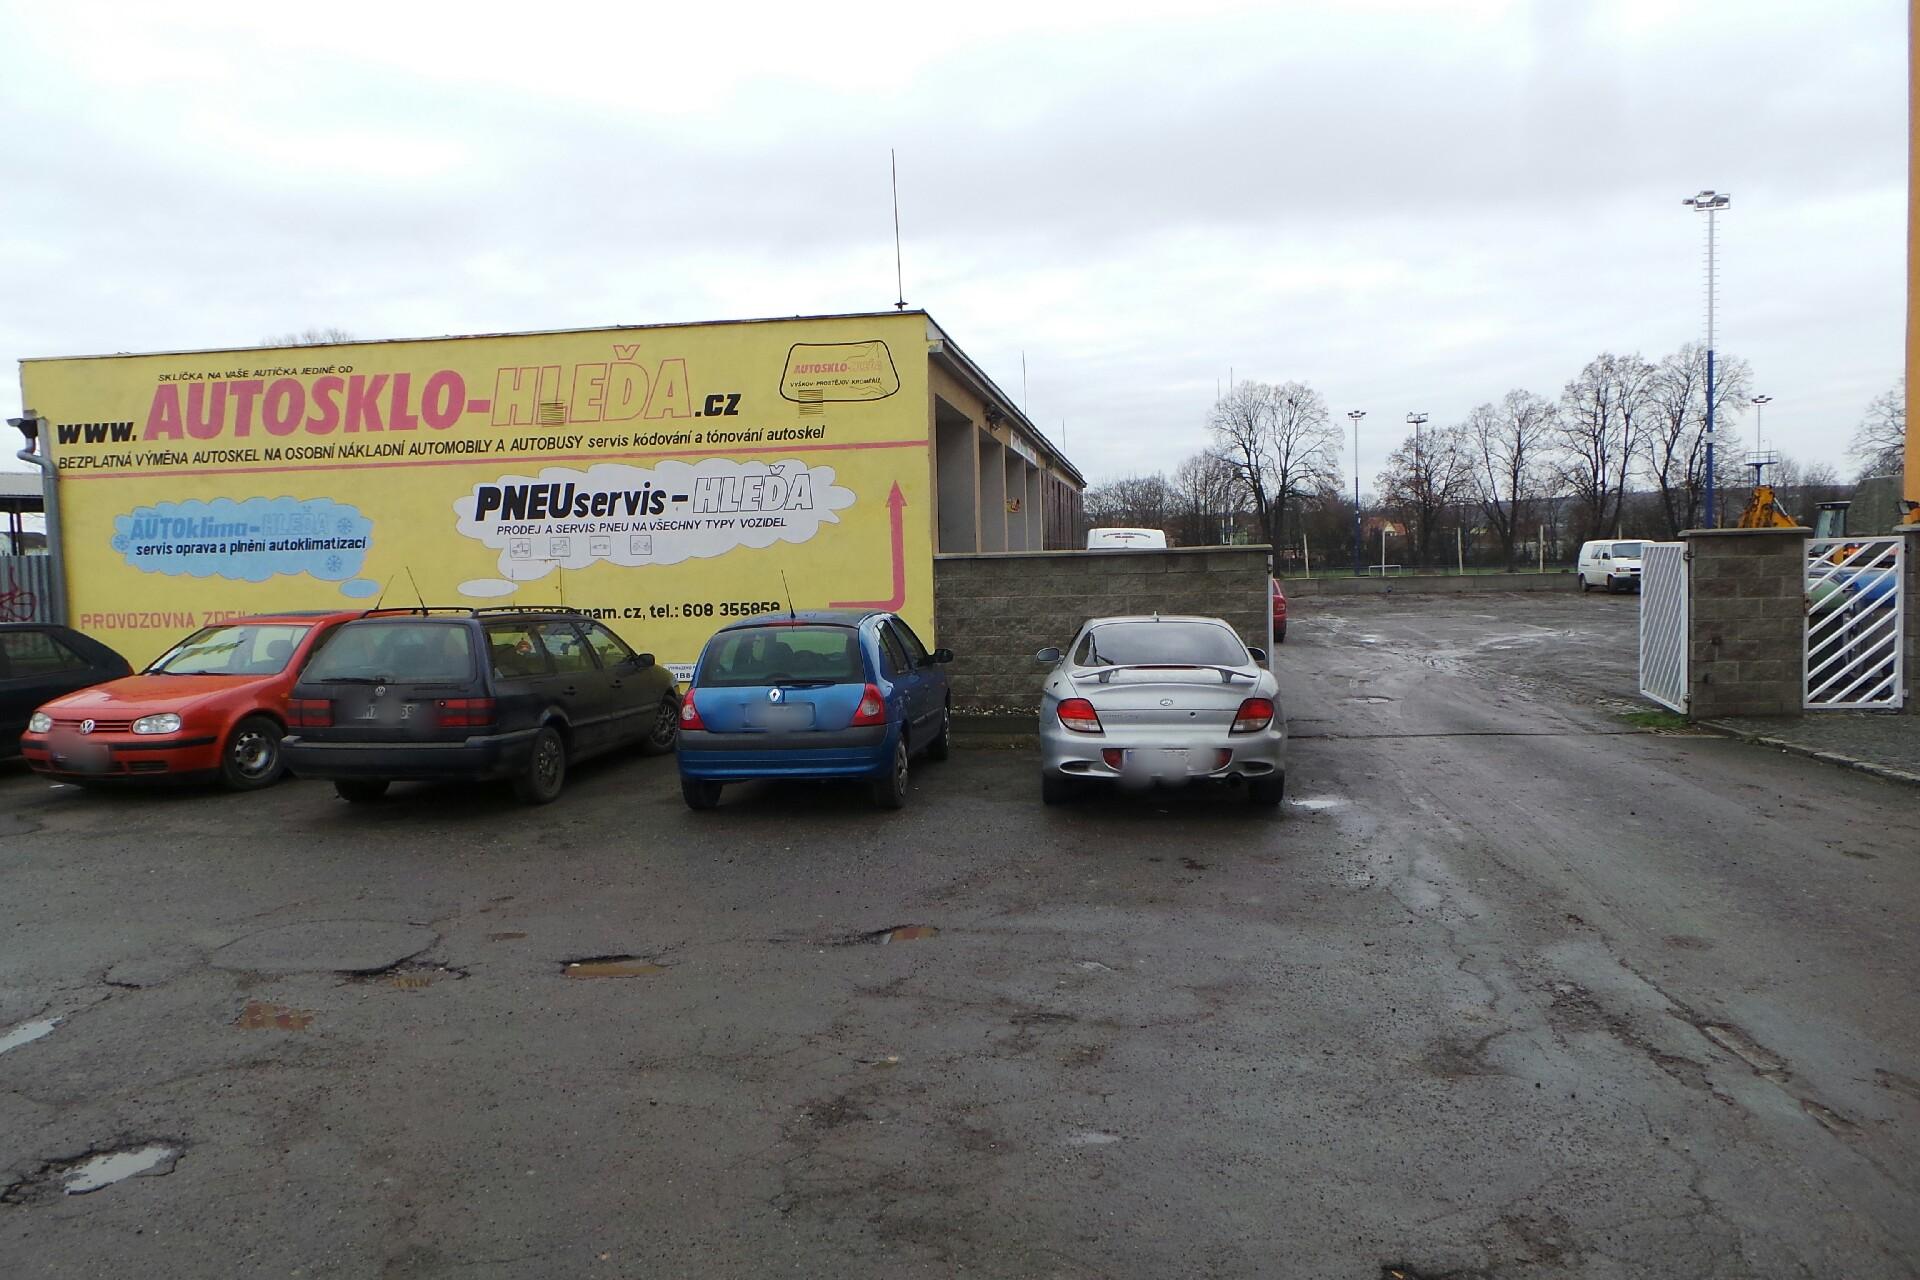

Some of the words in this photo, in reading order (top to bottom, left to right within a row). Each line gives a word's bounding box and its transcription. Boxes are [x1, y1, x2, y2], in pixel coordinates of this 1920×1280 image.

[225, 368, 249, 378] VAŠE
[338, 365, 353, 374] OD
[58, 451, 133, 469] BEZPLATNÁ
[136, 450, 189, 466] VÝMĚNA
[192, 448, 260, 464] AUTOSKEL
[264, 447, 283, 462] NA
[285, 442, 335, 460] OSOBNÍ
[338, 439, 405, 459] NÁKLADNÍ
[408, 439, 492, 456] AUTOMOBILY
[495, 438, 505, 452] A
[510, 435, 584, 452] AUTOBUSY
[587, 433, 629, 449] servis
[632, 428, 693, 447] kódování
[695, 433, 703, 444] a
[706, 426, 765, 444] tónování
[766, 424, 826, 442] autoskel
[496, 523, 541, 536] PRODEJ
[545, 523, 553, 534] A
[555, 522, 596, 534] SERVIS
[599, 521, 629, 533] PNEU
[631, 522, 647, 532] NA
[649, 517, 702, 532] VŠECHNY
[706, 518, 735, 530] TYPY
[740, 516, 787, 529] VOZIDEL
[135, 541, 173, 556] servis
[176, 542, 217, 556] oprava
[219, 543, 227, 553] a
[268, 535, 367, 552] autoklimatizací
[80, 611, 196, 629] PROVOZOVNA
[650, 604, 679, 618] tel.:
[682, 603, 714, 617] 608
